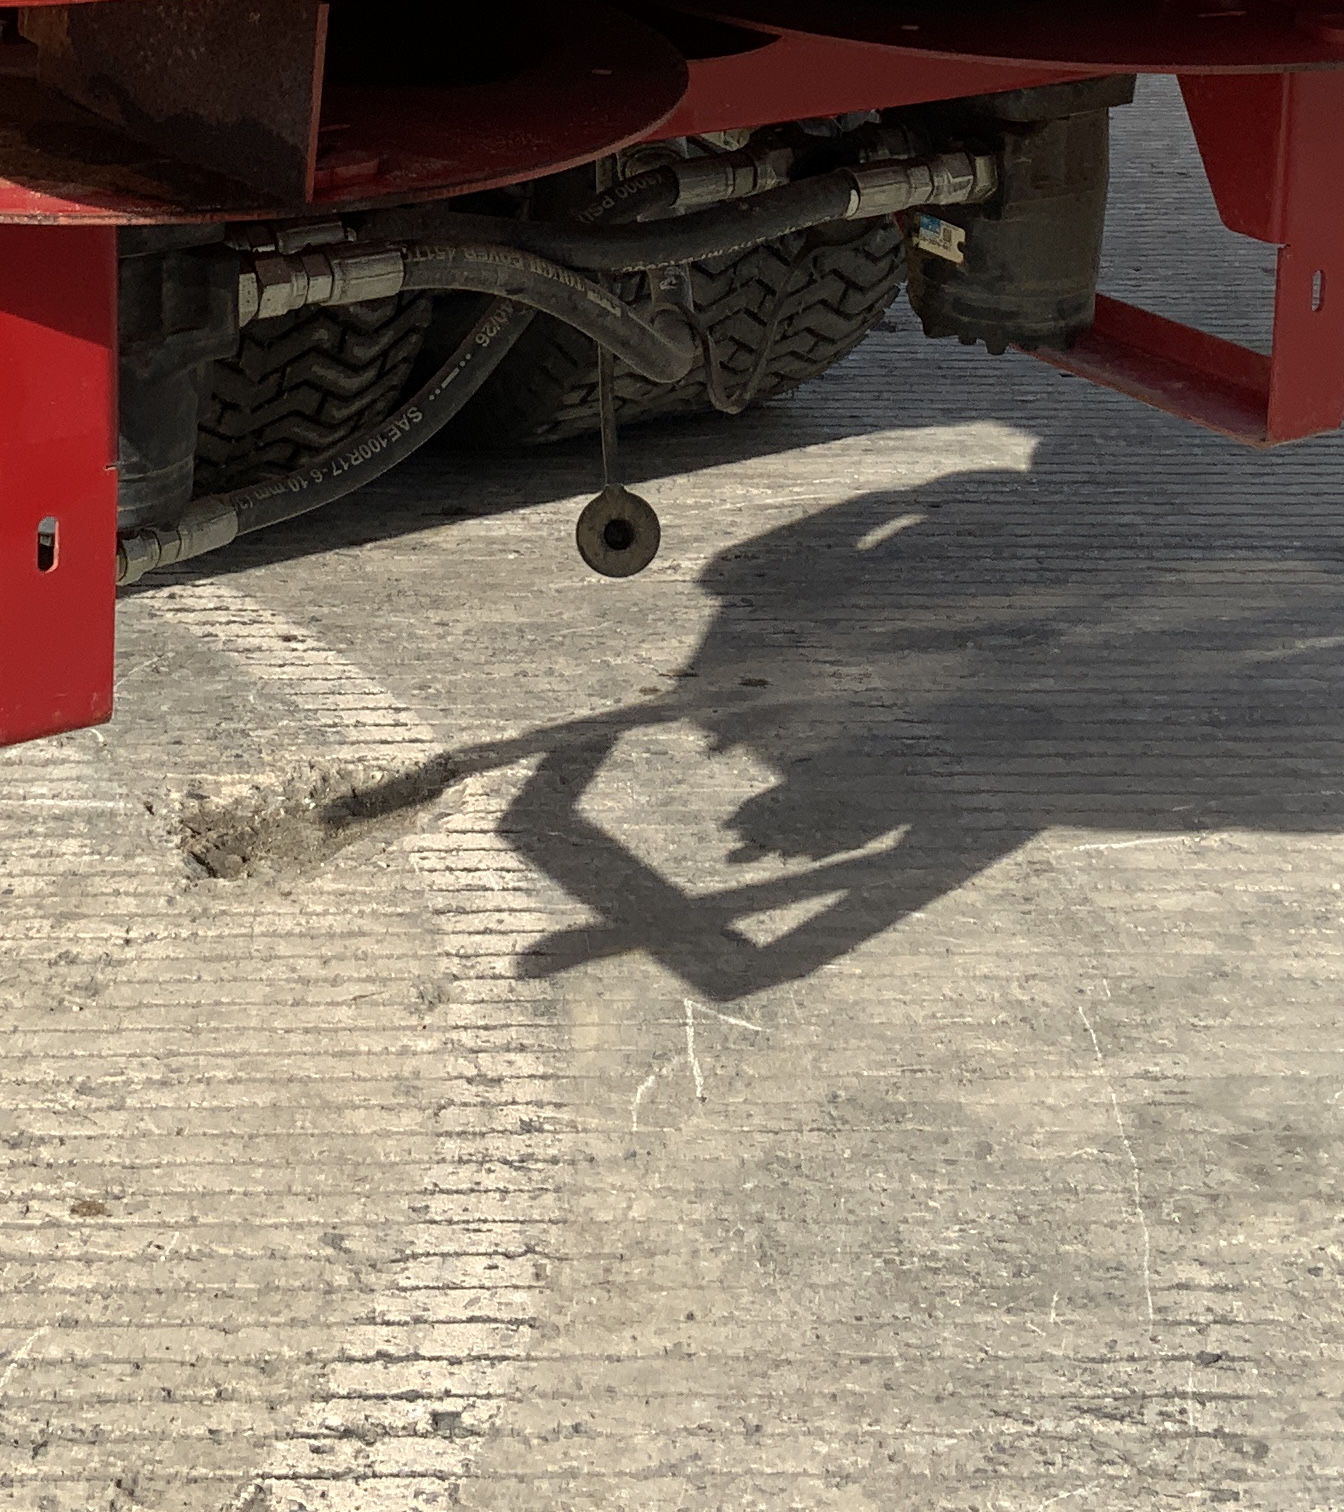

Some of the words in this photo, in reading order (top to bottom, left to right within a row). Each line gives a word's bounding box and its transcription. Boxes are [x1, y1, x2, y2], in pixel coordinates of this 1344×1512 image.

[463, 247, 524, 270] COVER
[256, 483, 289, 500] mm
[291, 478, 309, 493] 10
